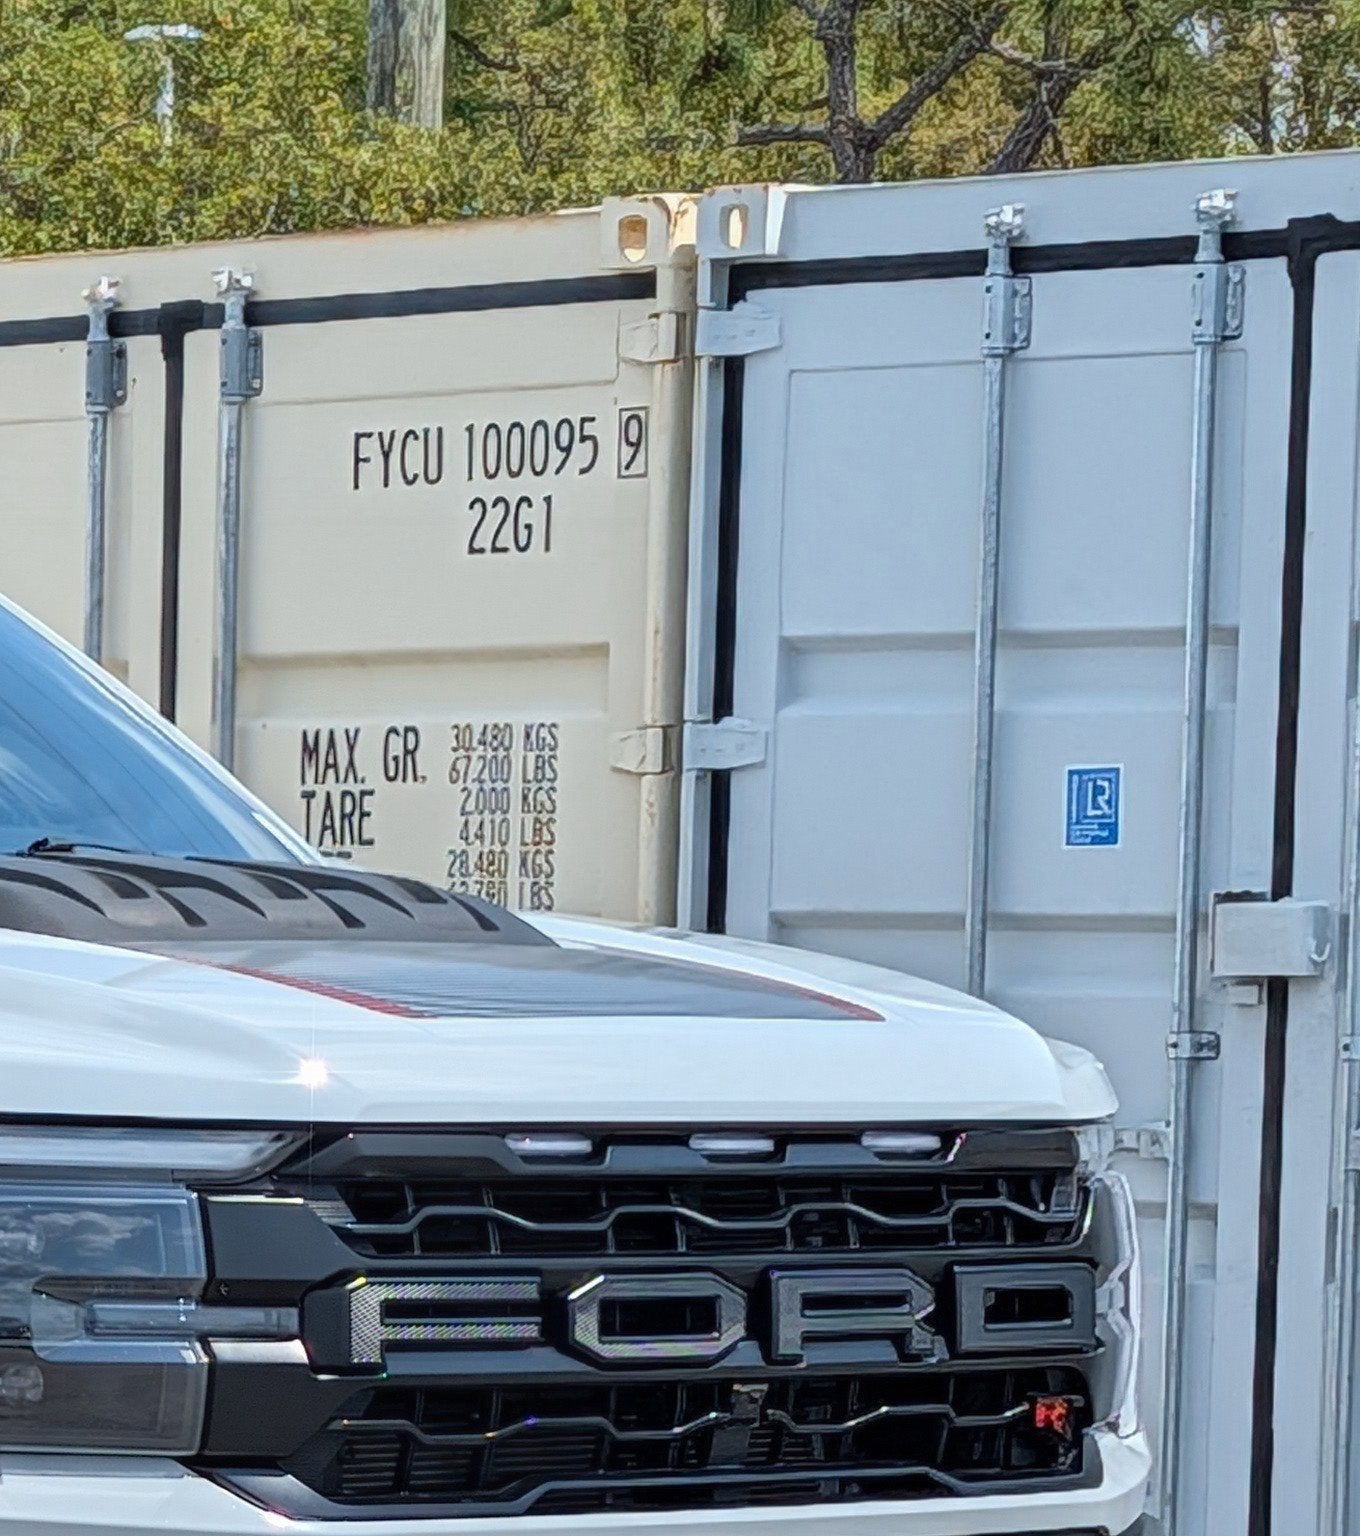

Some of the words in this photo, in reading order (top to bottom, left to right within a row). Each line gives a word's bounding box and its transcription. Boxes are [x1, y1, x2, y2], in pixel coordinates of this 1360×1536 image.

[352, 426, 444, 491] FYCU
[465, 416, 599, 482] 100095
[622, 412, 646, 472] 9
[467, 494, 554, 556] 22G1
[300, 728, 366, 786] MAX.
[523, 722, 559, 752] KGS
[522, 754, 558, 784] LBS
[301, 788, 375, 847] TARE
[521, 786, 557, 814] KGS
[520, 817, 556, 846] LBS
[519, 848, 555, 878] KGS
[346, 1262, 1099, 1369] FORD
